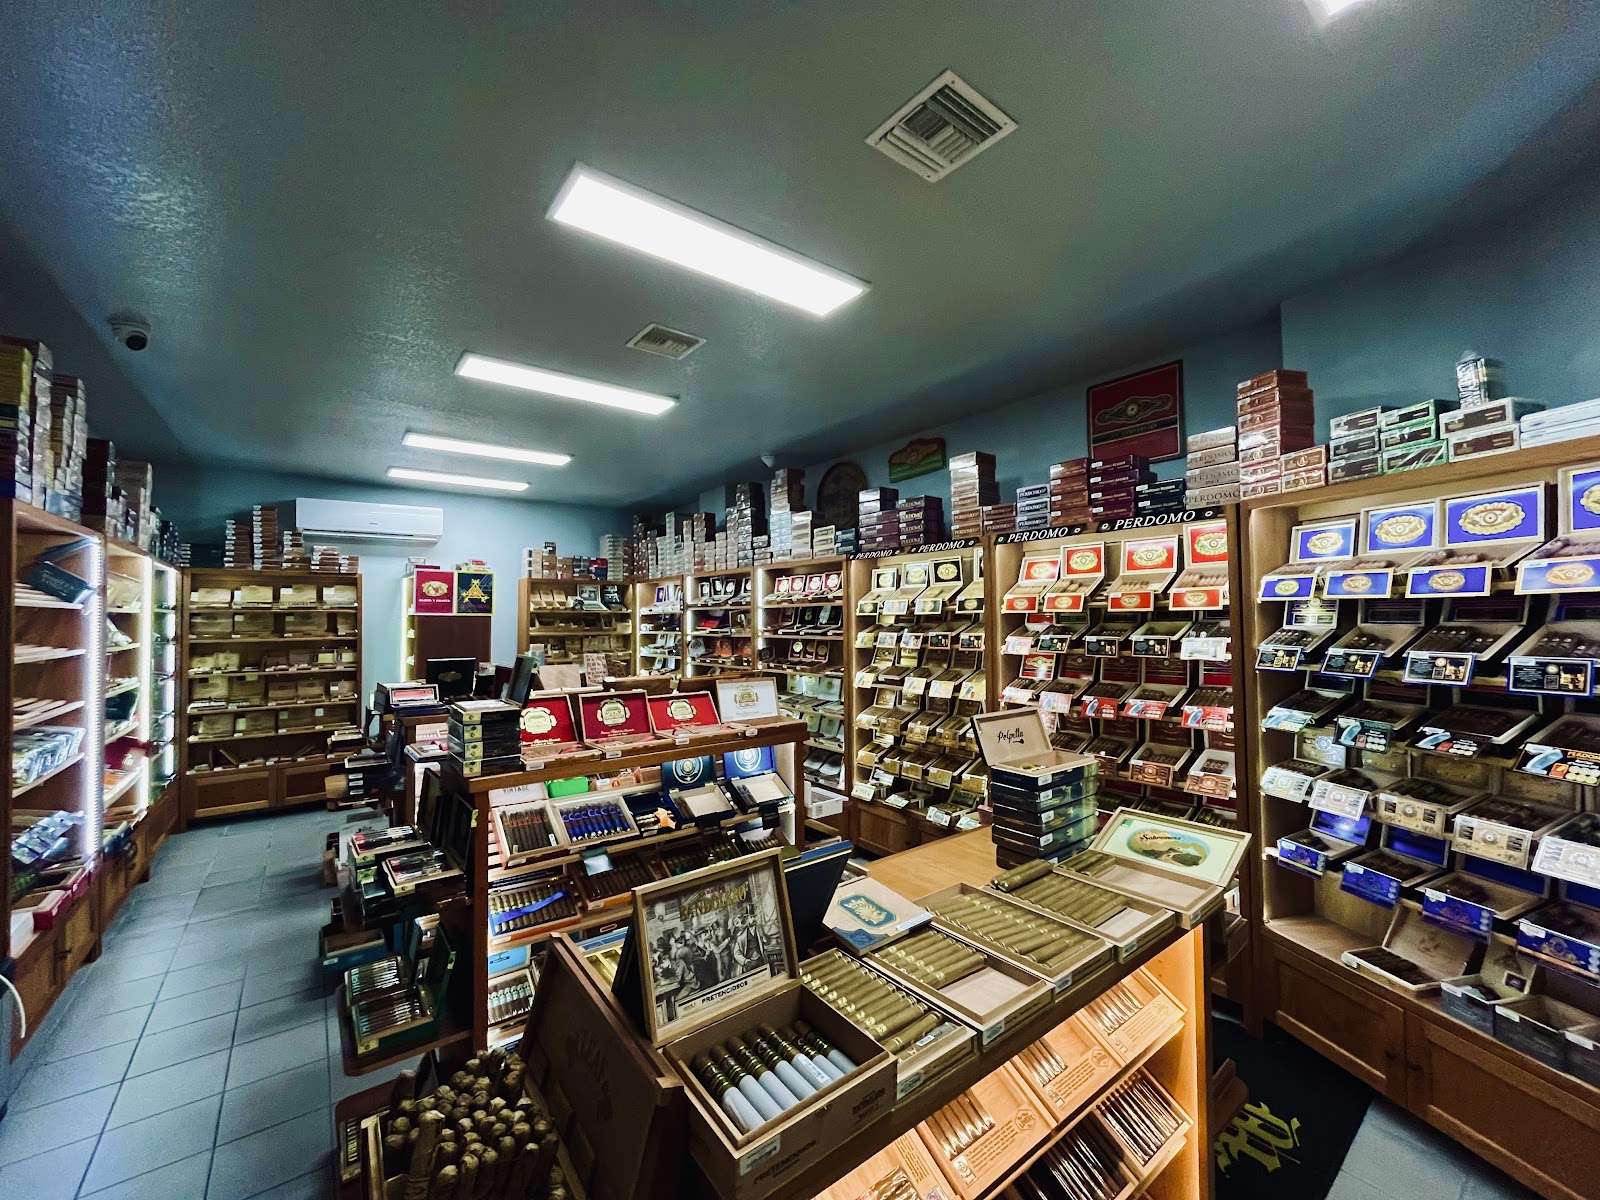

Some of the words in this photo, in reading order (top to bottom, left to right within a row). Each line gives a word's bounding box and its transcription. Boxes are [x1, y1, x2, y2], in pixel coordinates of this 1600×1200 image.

[1190, 450, 1232, 464] PERDOMO
[1188, 468, 1239, 484] PERDOMO
[1188, 490, 1240, 503] PERDOMO
[1114, 510, 1196, 531] PERDOMO
[1007, 526, 1069, 543] PERDOMO
[918, 540, 965, 553] PERDOMO
[855, 549, 893, 560] PERDOMO
[701, 980, 748, 1005] PRETENCIOSOS
